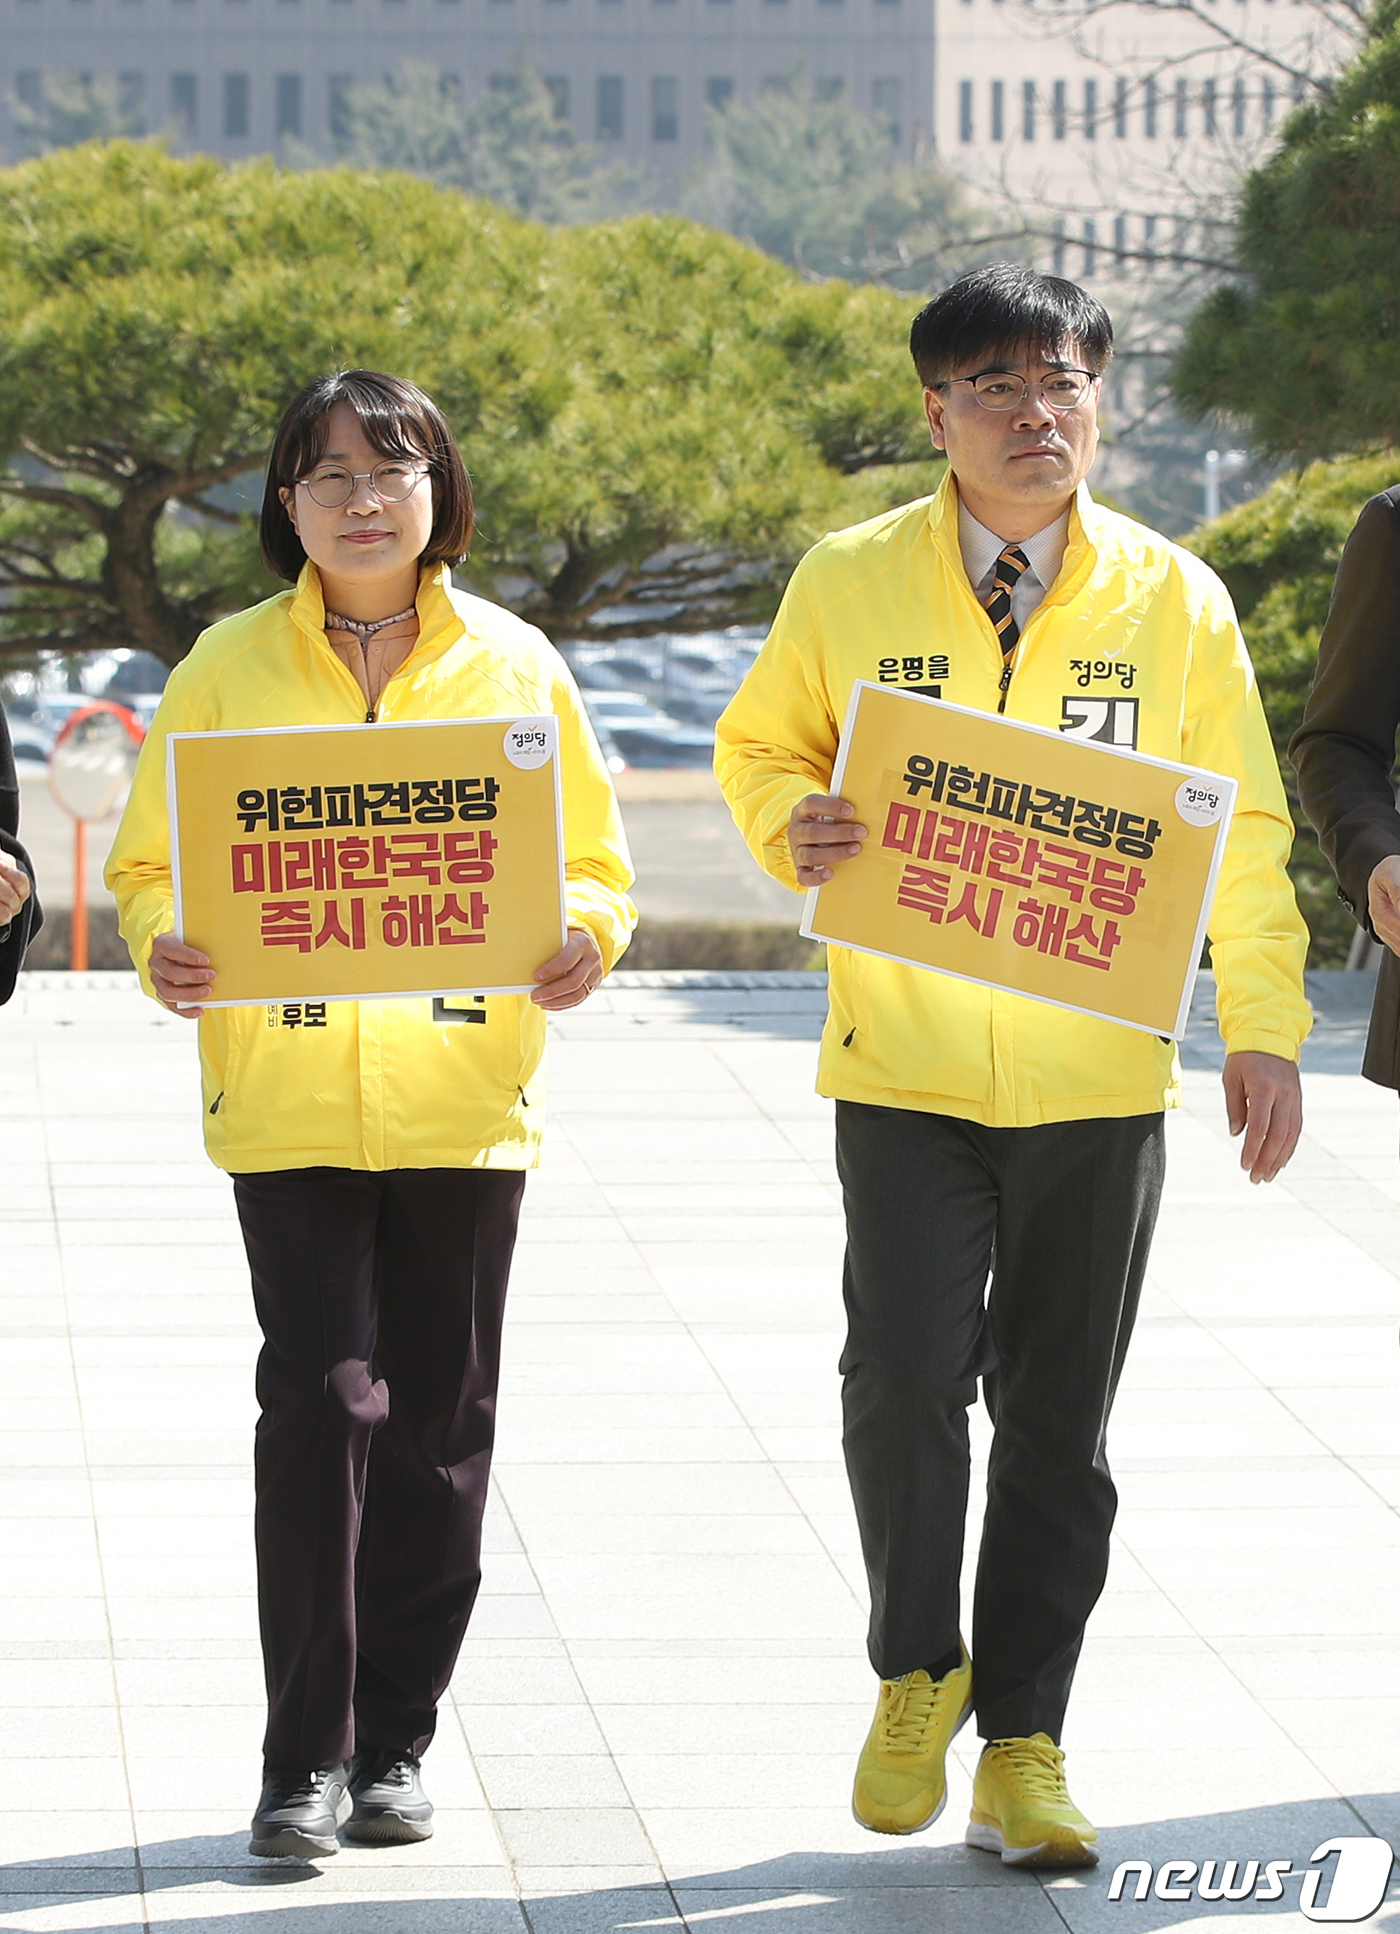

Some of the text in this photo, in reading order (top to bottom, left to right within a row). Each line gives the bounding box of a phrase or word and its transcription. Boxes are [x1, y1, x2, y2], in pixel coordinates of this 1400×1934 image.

[878, 654, 950, 682] 은평을
[1069, 659, 1138, 690] 정의당
[511, 732, 547, 748] 정의당
[236, 776, 500, 833] 위헌파견정당
[903, 754, 1162, 860] 위헌파견정당
[1184, 786, 1220, 809] 정의당
[230, 830, 498, 894] 미래한국당
[881, 801, 1147, 916] 미래한국당
[260, 891, 490, 954] 즉시 해산
[897, 863, 1122, 971] 즉시 해산
[282, 1002, 327, 1030] 후보
